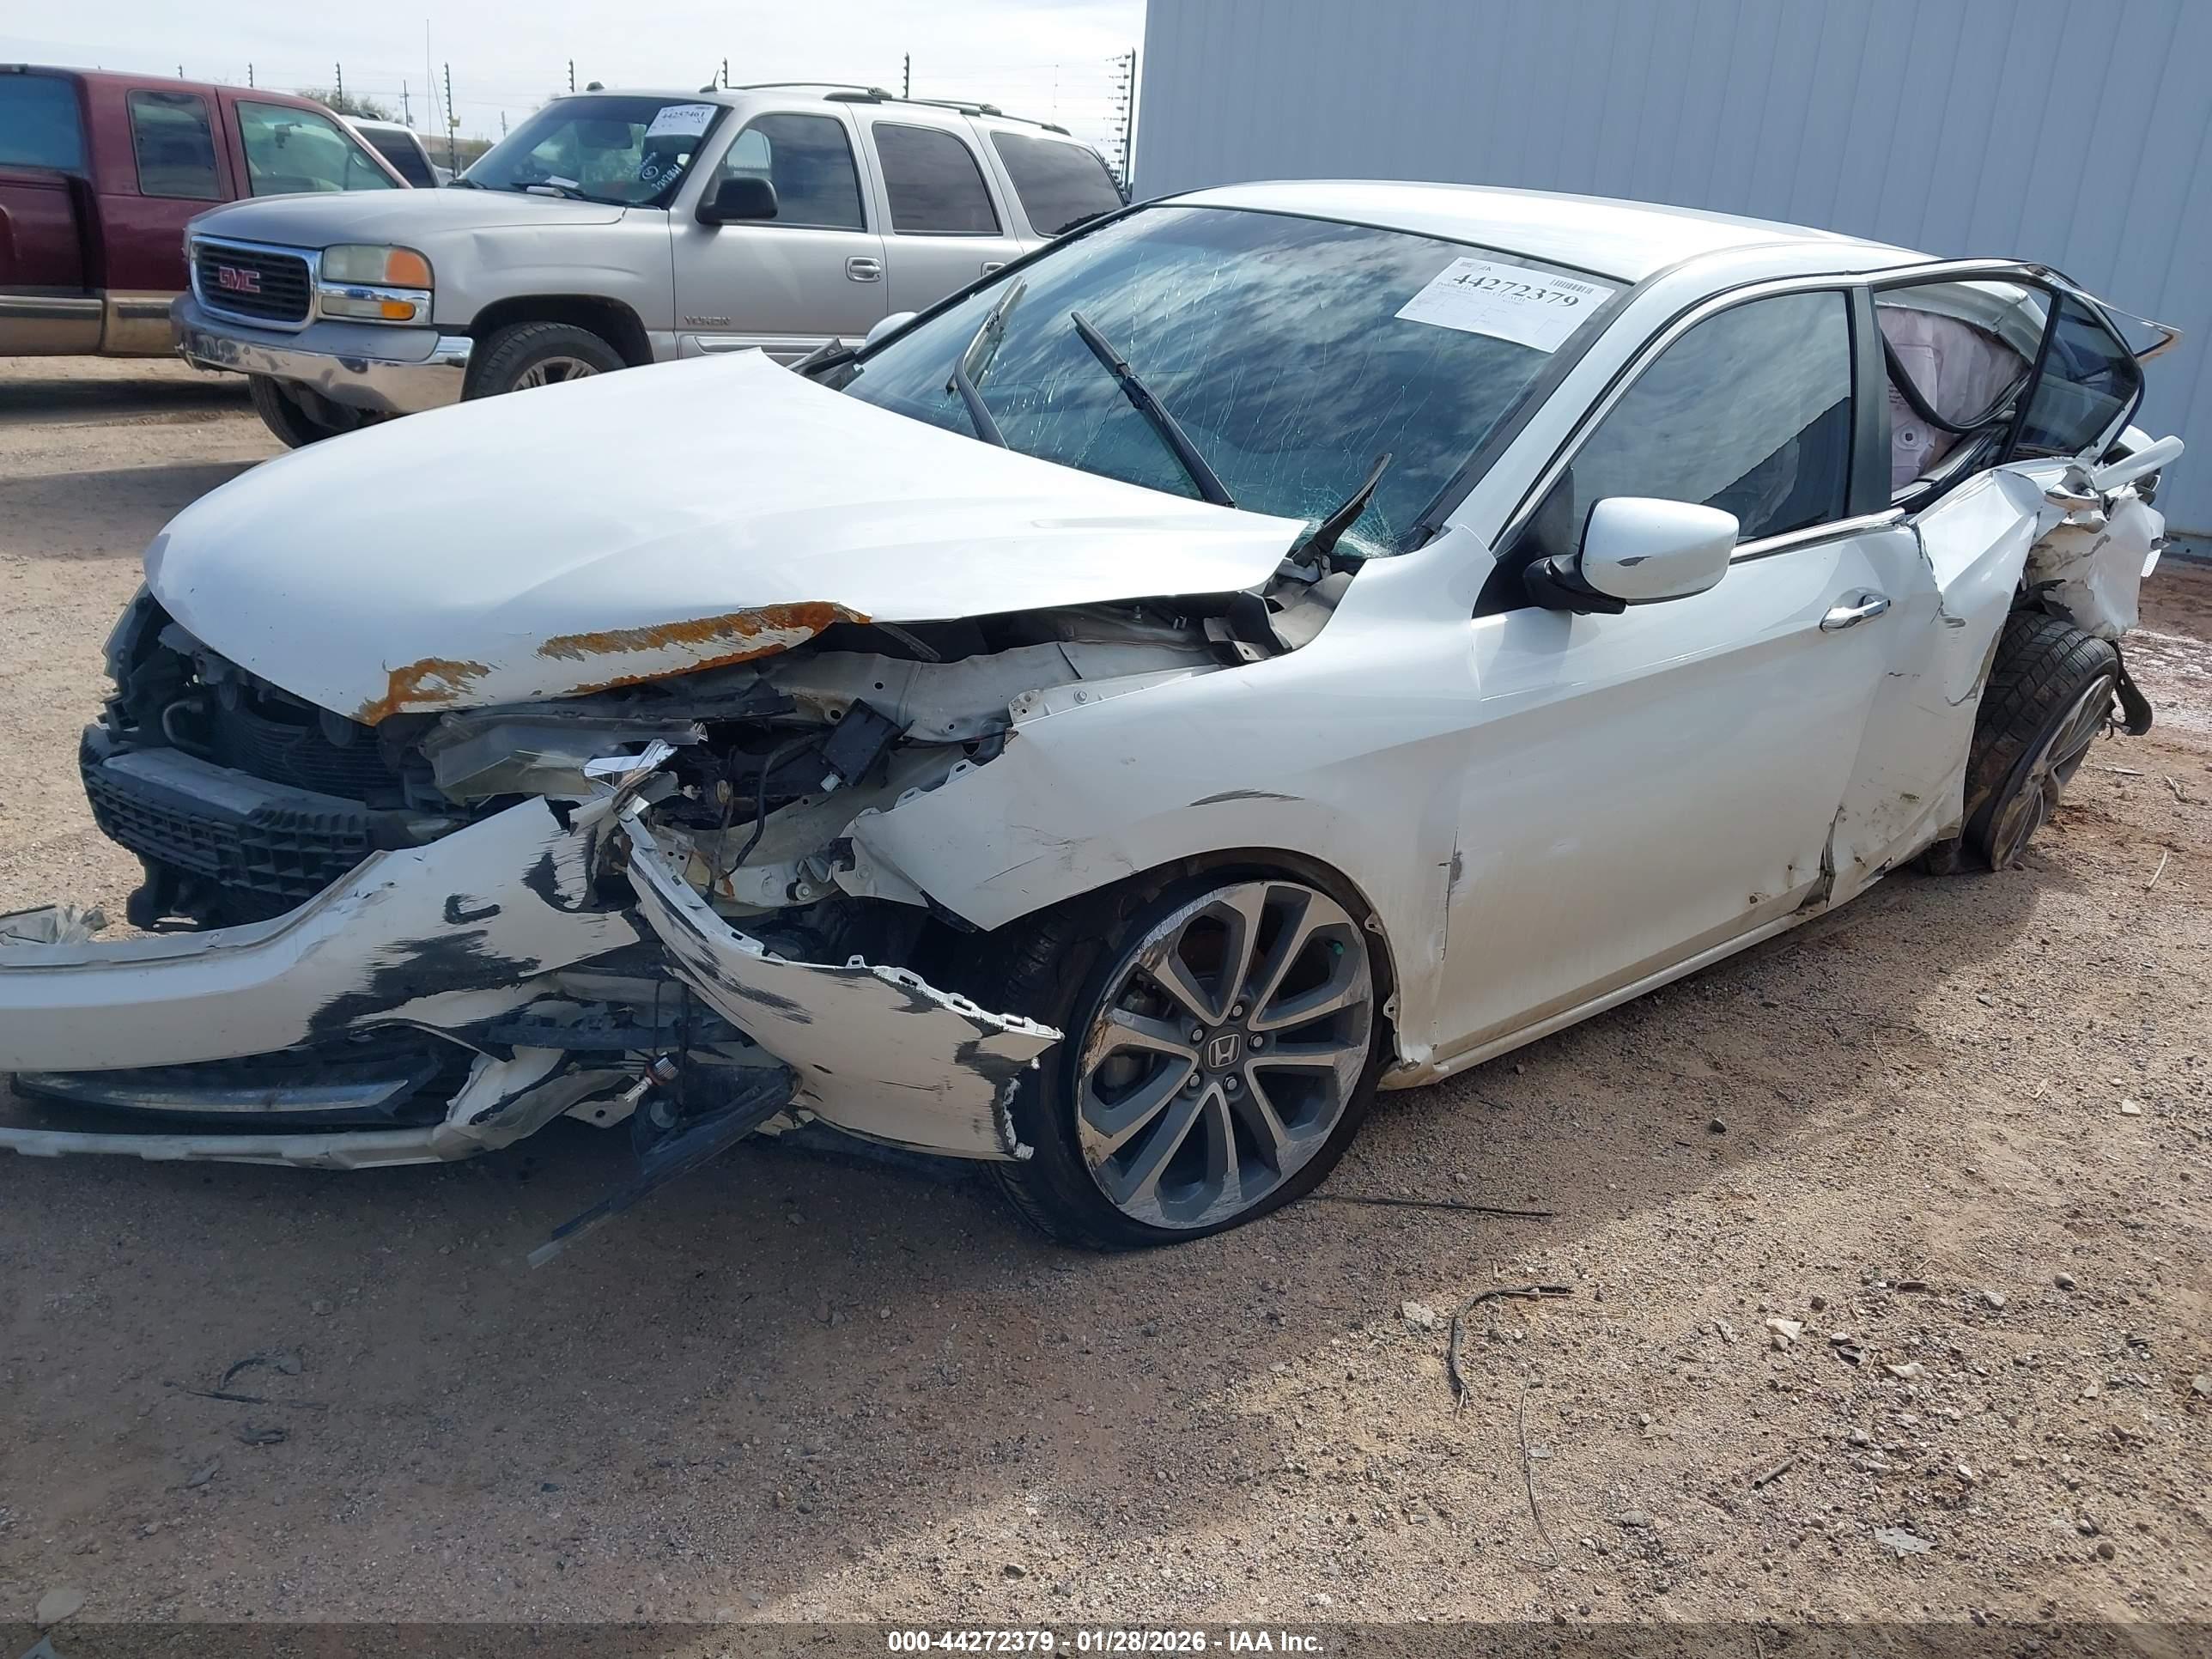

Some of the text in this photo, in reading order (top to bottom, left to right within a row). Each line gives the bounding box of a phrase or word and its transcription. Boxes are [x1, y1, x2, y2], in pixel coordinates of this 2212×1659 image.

[219, 266, 261, 293] GMC
[1453, 273, 1579, 307] 44272379
[684, 315, 731, 326] YUKON
